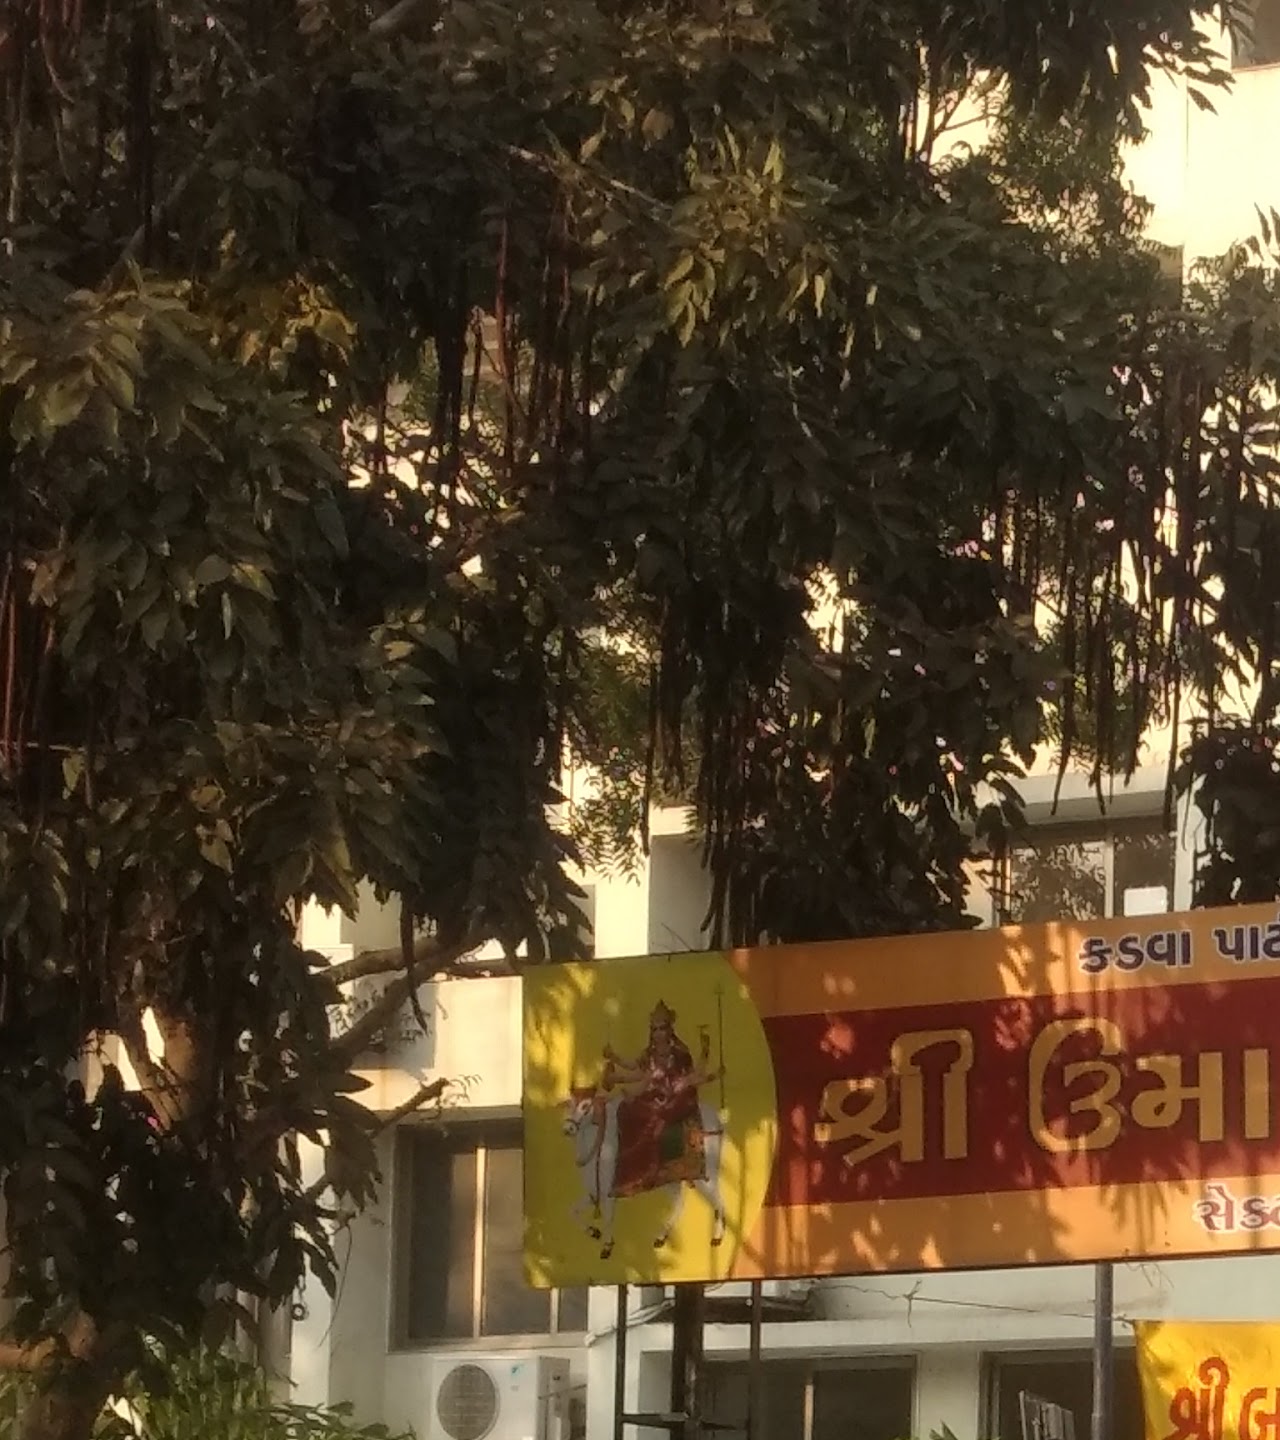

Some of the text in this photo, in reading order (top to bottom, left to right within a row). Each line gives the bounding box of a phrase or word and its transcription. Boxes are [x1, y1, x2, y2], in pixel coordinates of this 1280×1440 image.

[1079, 914, 1193, 974] કડવા
[813, 1028, 976, 1169] શ્રી
[1028, 1016, 1270, 1155] ઉમા
